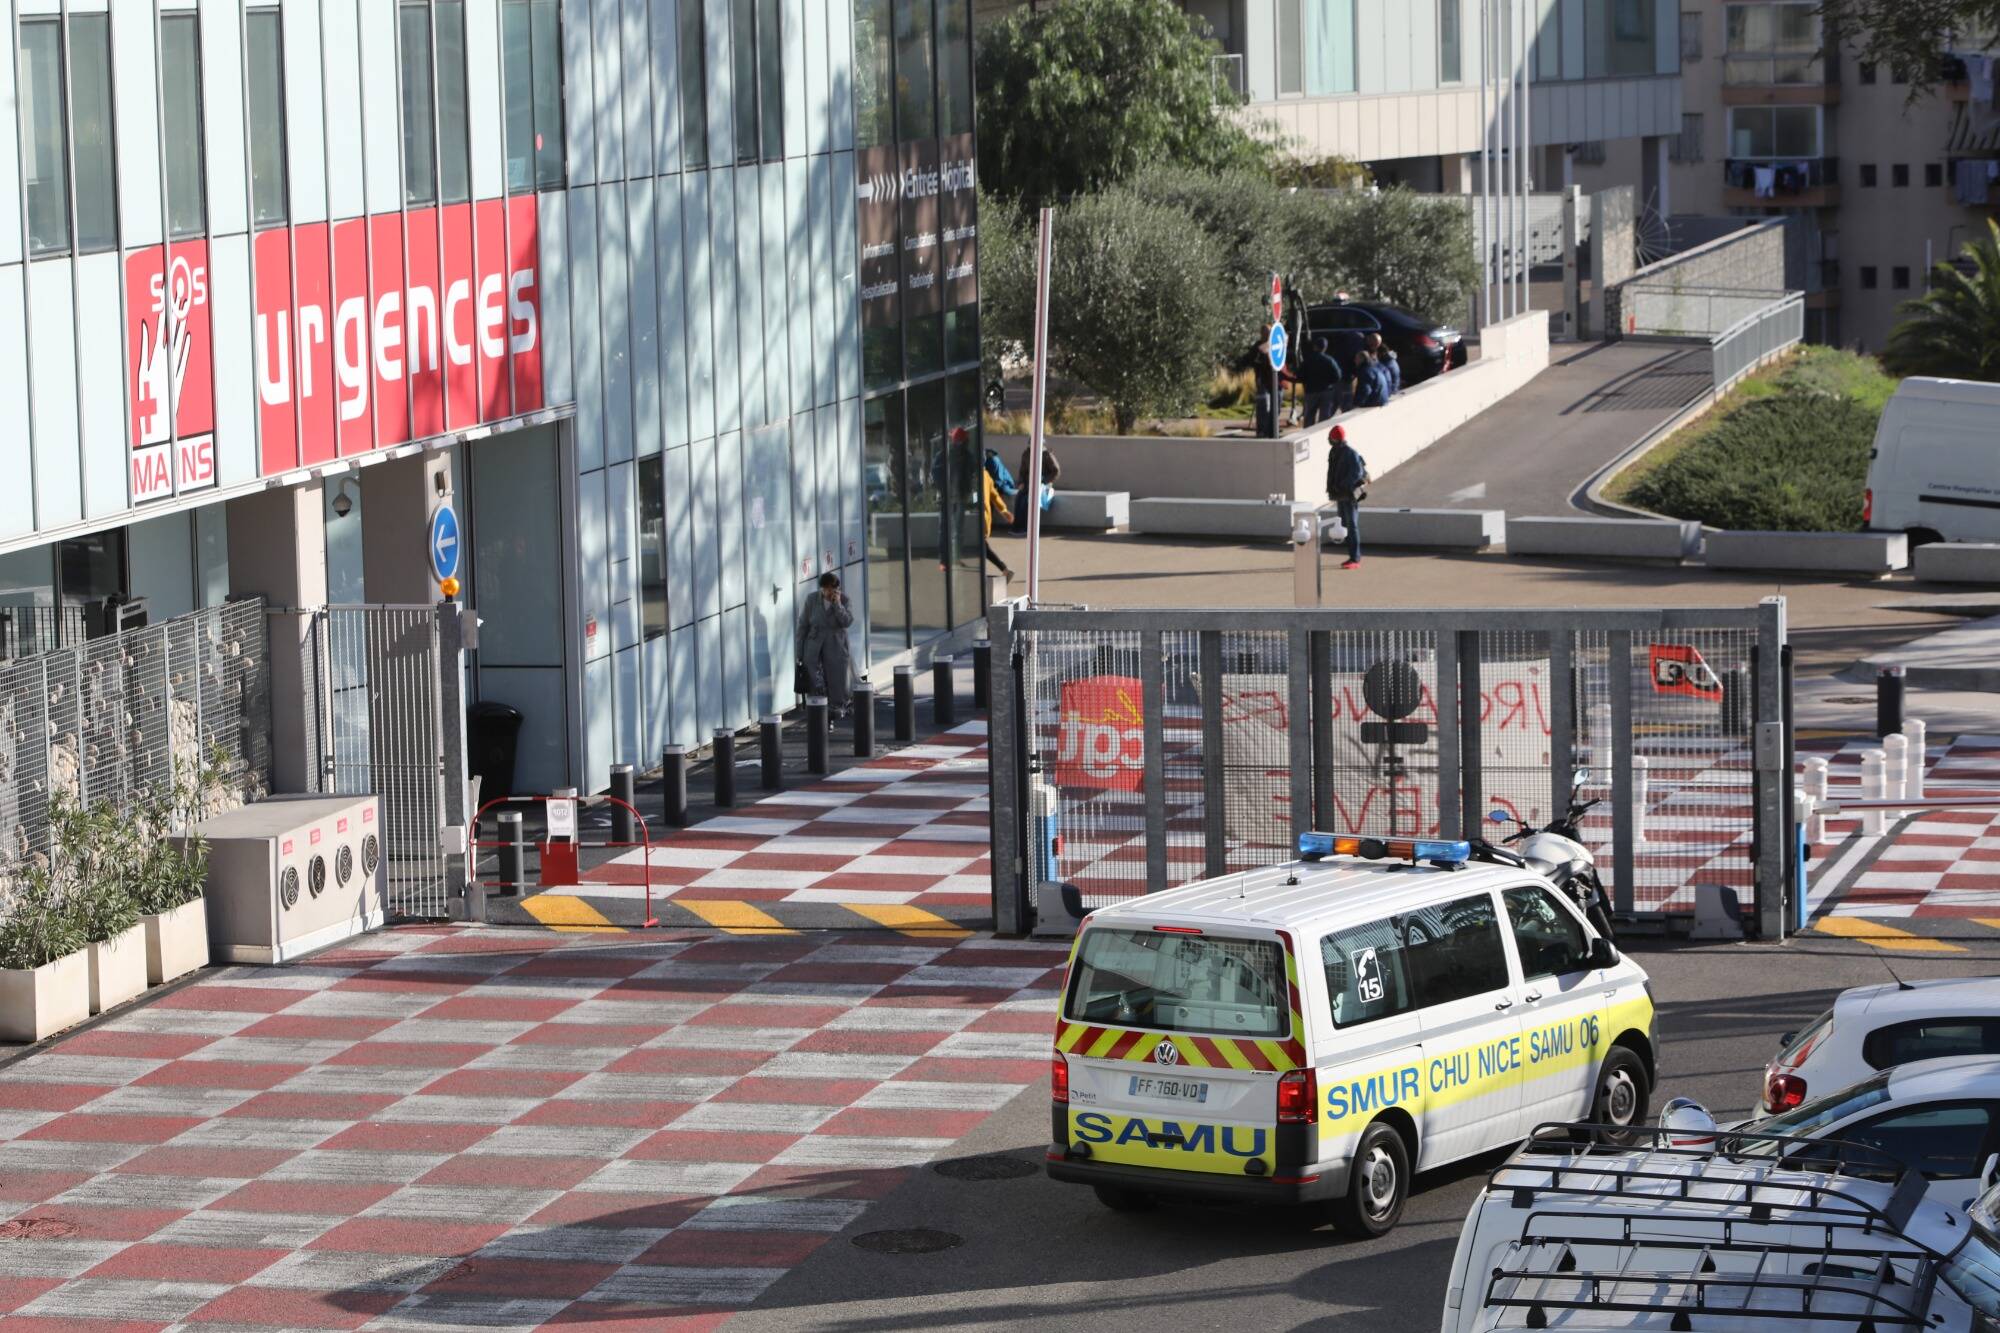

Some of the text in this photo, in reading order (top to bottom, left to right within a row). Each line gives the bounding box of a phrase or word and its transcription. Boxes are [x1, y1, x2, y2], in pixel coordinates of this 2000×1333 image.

[905, 158, 975, 199] Entrée Hôpital
[149, 256, 207, 321] SOS
[1360, 976, 1381, 1001] 15
[1326, 1066, 1420, 1120] SMUR
[1429, 1051, 1470, 1093] CHU
[1478, 1036, 1521, 1078] NICE
[1529, 1023, 1574, 1064] SAMU
[1074, 1112, 1267, 1157] SAMU
